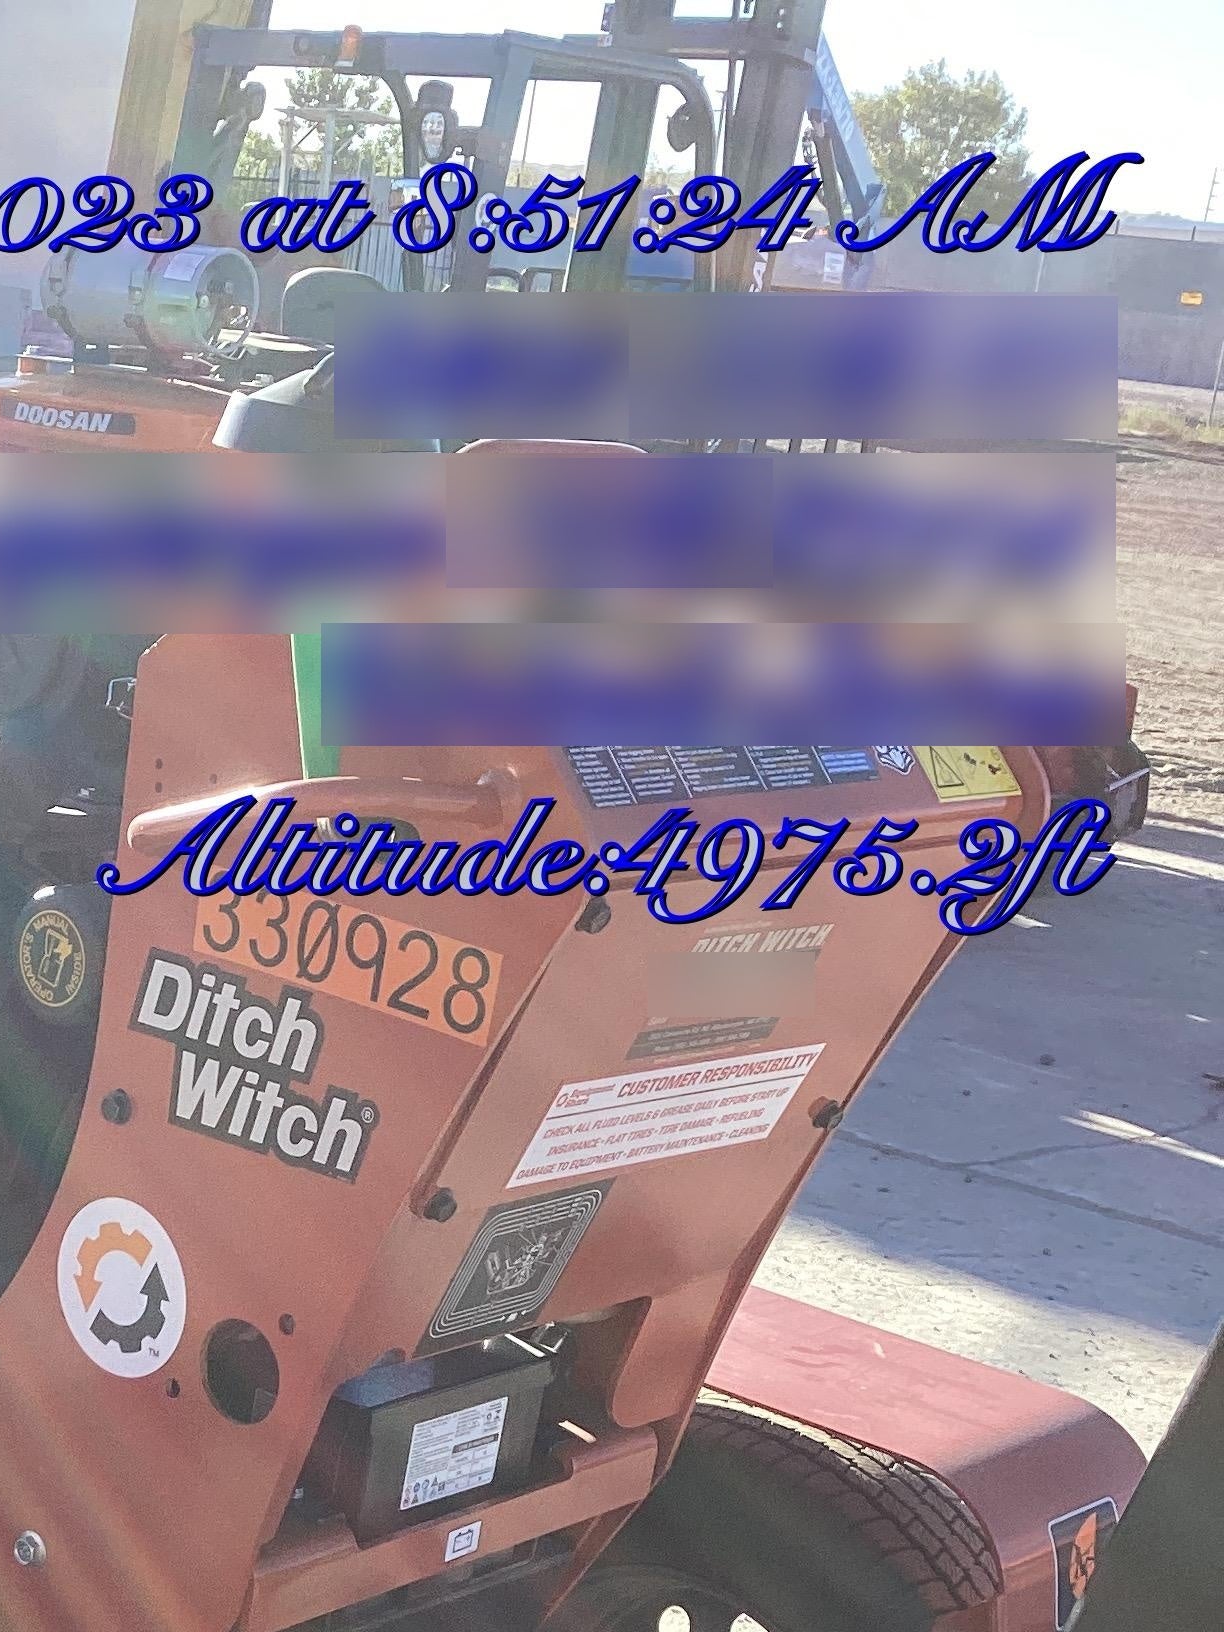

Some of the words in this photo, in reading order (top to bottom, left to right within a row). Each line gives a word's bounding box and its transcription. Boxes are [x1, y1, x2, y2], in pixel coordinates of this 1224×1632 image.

[14, 402, 112, 432] DOOSAN
[203, 870, 491, 1034] 330928
[137, 958, 319, 1075] Ditch
[617, 1071, 702, 1098] CUSTOMER
[699, 1052, 820, 1085] RESPONSIBILITY
[574, 1121, 592, 1133] ALL
[619, 1110, 651, 1125] LEVELS
[546, 1139, 601, 1157] INSURANCE
[604, 1132, 627, 1145] FLAT
[626, 1142, 667, 1159] BATTERY
